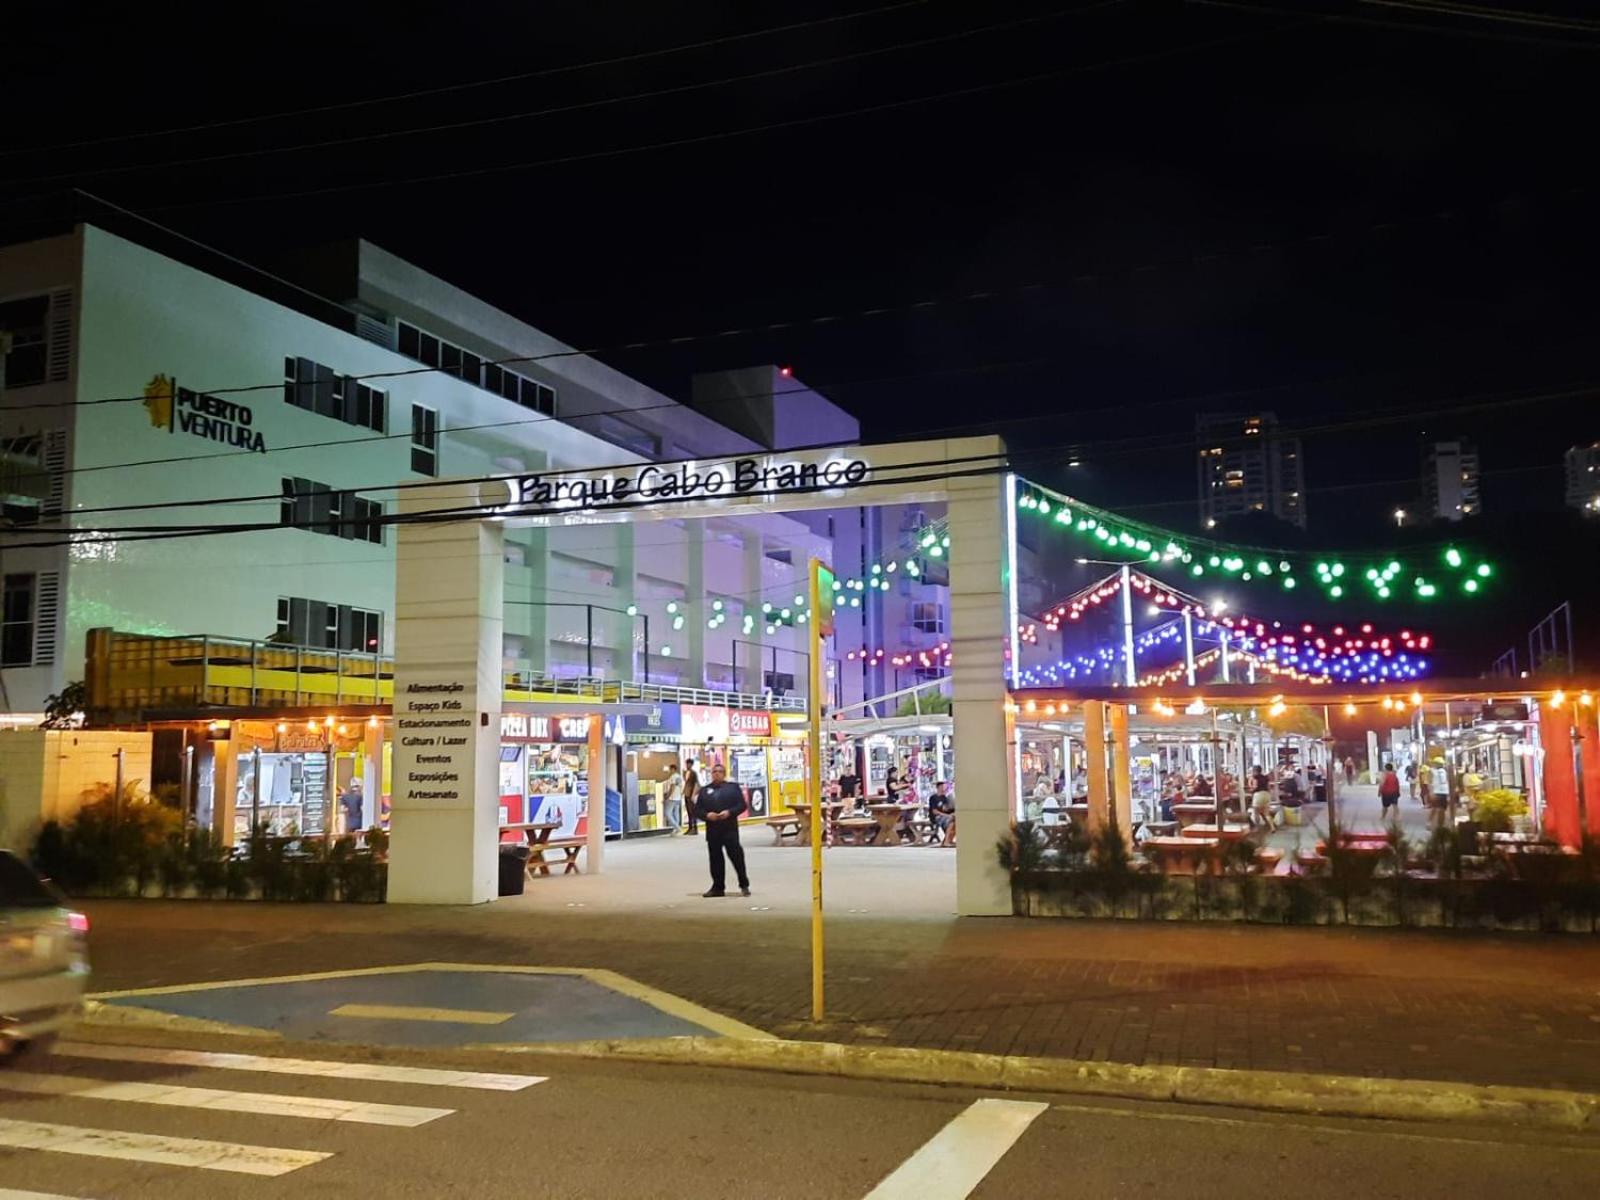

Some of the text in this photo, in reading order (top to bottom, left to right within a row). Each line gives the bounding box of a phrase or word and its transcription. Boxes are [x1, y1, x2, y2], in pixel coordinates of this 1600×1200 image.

[178, 386, 252, 426] PUERTO
[178, 409, 266, 454] VENTURA
[519, 459, 867, 508] Parque Cabo Branco
[407, 682, 464, 694] Alimentação
[408, 700, 462, 713] Espaço Kids
[399, 719, 471, 729] Estacionamento
[402, 736, 434, 746] Cultura
[442, 736, 468, 745] Lazer
[416, 753, 451, 763] Eventos
[408, 771, 458, 784] Exposições
[407, 789, 458, 799] Artesanato
